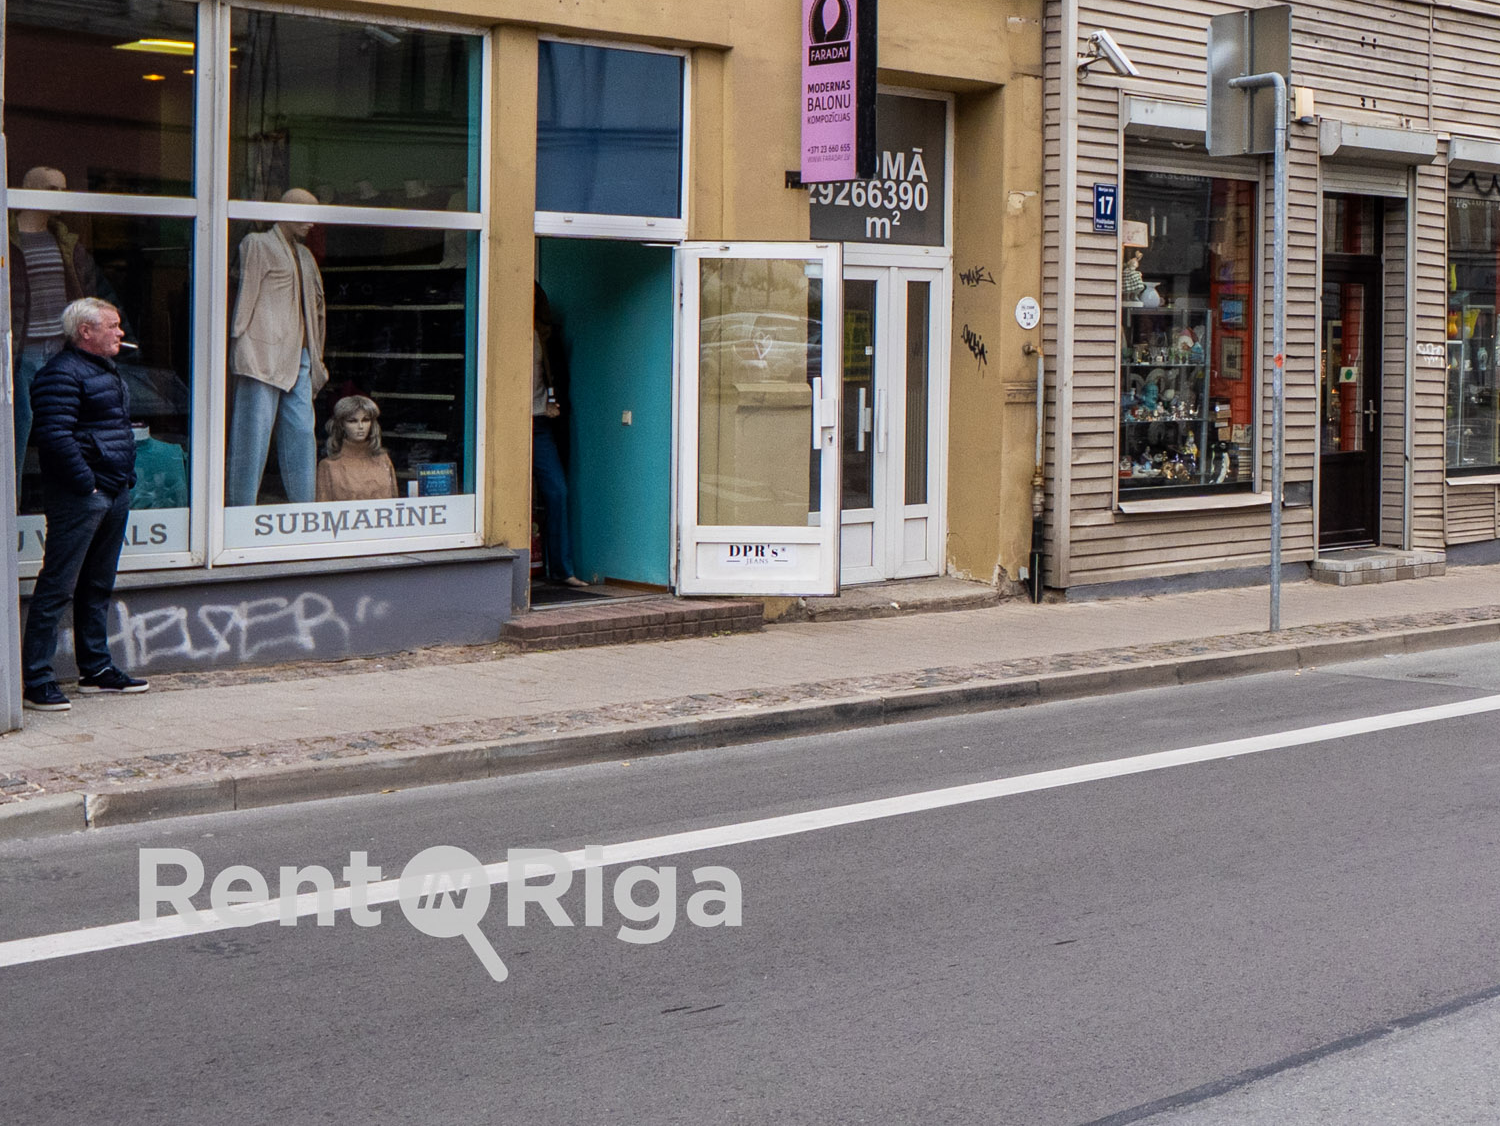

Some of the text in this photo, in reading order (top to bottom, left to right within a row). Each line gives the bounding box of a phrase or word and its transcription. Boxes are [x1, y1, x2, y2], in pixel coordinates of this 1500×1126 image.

[810, 46, 849, 62] FARADAY
[807, 80, 850, 94] MODERNAS
[807, 94, 851, 112] BALONU
[807, 112, 851, 124] KOMPOZĪCIJAS
[808, 143, 851, 154] +371 23 660 655
[876, 147, 929, 183] MĀ
[1098, 195, 1115, 215] 17
[254, 502, 447, 540] SUBMARĪNE
